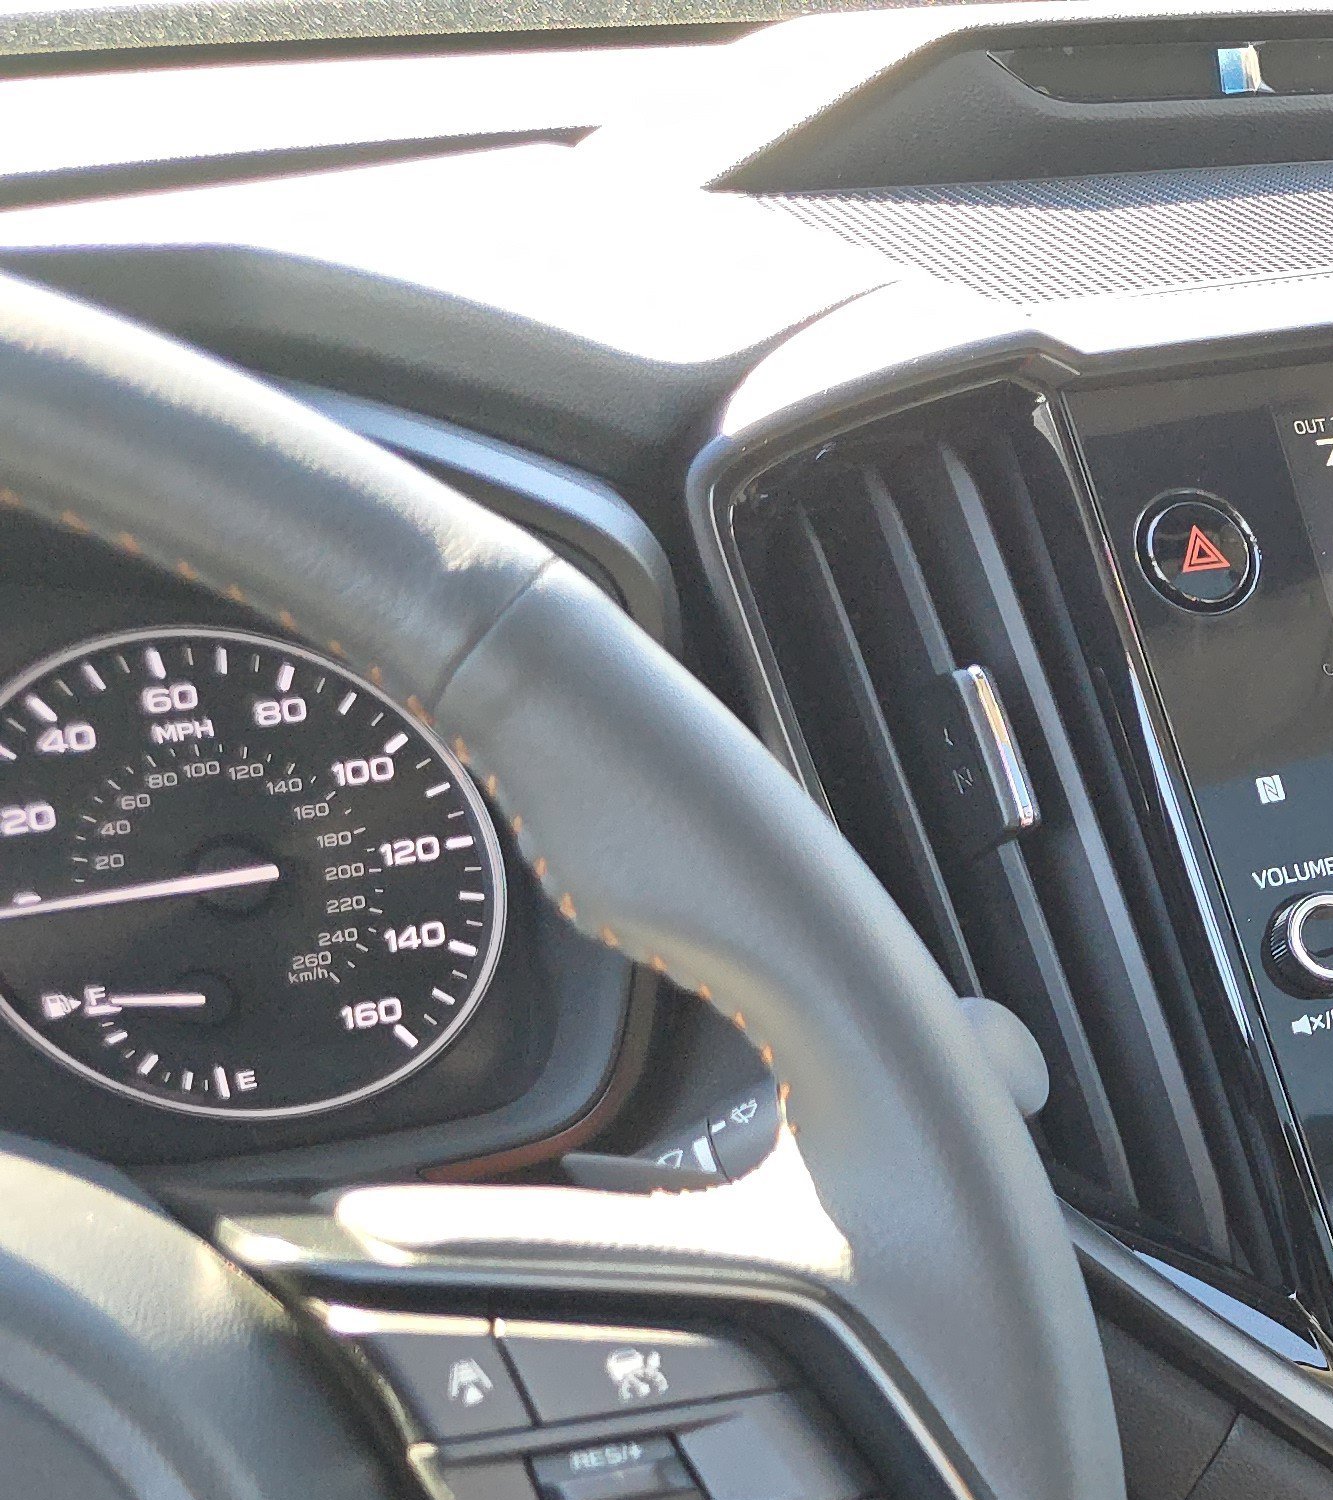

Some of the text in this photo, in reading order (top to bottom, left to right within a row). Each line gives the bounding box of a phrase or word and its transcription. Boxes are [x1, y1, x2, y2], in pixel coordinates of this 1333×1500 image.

[1293, 418, 1326, 435] OUT
[142, 682, 199, 713] 60
[253, 696, 307, 726] 80
[36, 722, 97, 753] 40
[151, 719, 215, 744] MPH
[182, 760, 221, 778] 100
[228, 763, 264, 781] 120
[330, 756, 395, 787] 100
[146, 771, 178, 789] 80
[265, 777, 303, 795] 140
[120, 793, 151, 810] 60
[293, 802, 330, 820] 160
[0, 802, 57, 836] 20
[100, 819, 131, 836] 40
[316, 830, 352, 849] 180
[379, 836, 440, 867] 120
[94, 853, 125, 870] 20
[324, 863, 365, 881] 200
[326, 895, 366, 914] 220
[318, 927, 358, 946] 240
[383, 920, 446, 953] 140
[292, 950, 332, 969] 260
[288, 966, 328, 984] km/h
[340, 998, 403, 1030] 160
[235, 1070, 258, 1090] E
